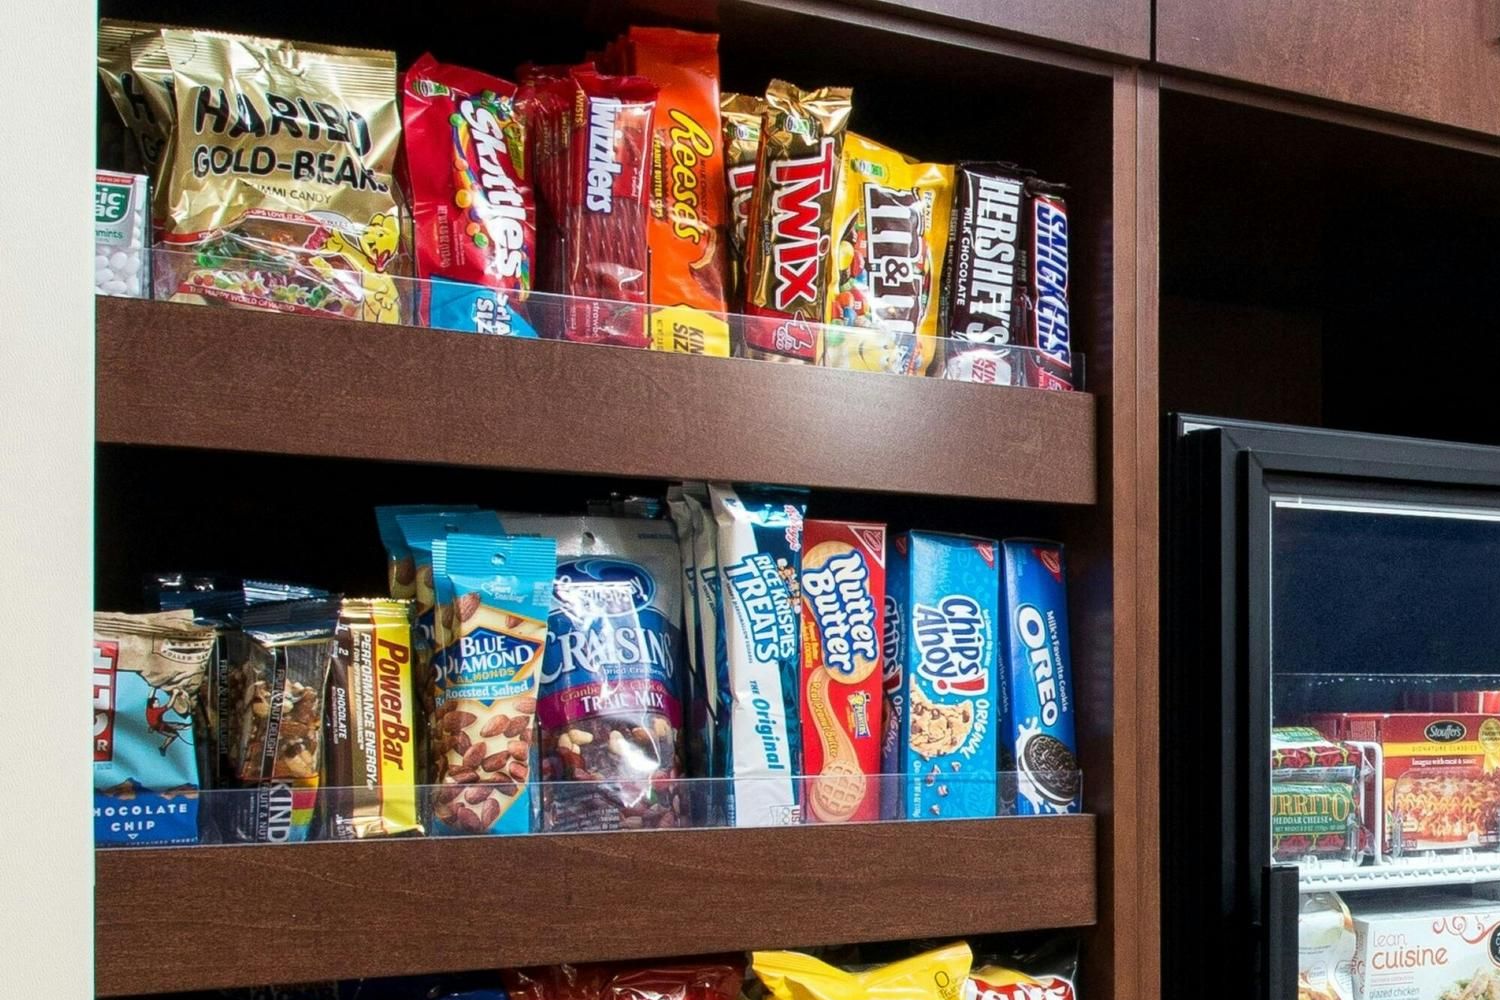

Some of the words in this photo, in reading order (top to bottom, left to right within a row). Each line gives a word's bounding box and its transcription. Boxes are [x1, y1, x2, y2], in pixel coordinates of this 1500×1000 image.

[461, 100, 526, 278] Skittles
[669, 109, 714, 245] Reese's
[290, 189, 332, 204] CANDY
[962, 207, 973, 236] MILK
[957, 238, 971, 306] CHOCOLATE
[967, 177, 1024, 345] HERSHEY'S
[1036, 203, 1071, 367] SNICKERS
[475, 297, 494, 334] SIZ
[674, 322, 689, 353] SIZ
[689, 327, 704, 354] KIN
[971, 356, 984, 383] SIZ
[981, 357, 998, 384] KIN
[724, 559, 778, 663] TREATS
[755, 555, 783, 588] RICE
[770, 589, 797, 658] KRISPIES
[803, 568, 853, 673] Butter
[828, 552, 878, 662] Nutter
[943, 598, 982, 676] Chips
[1046, 609, 1060, 639] Milk's
[446, 644, 535, 678] DIAMOND
[460, 633, 506, 658] BLUE
[540, 626, 674, 684] CRAISINS
[1052, 641, 1065, 680] Favorite
[274, 668, 285, 691] FRUIT
[361, 633, 376, 728] PERFORMANCE
[456, 667, 516, 685] ALMONDS
[1017, 604, 1059, 727] OREO
[446, 684, 490, 701] Roasted
[491, 680, 528, 697] Salted
[635, 691, 664, 709] MIX
[748, 680, 758, 694] THE
[810, 680, 823, 701] Real
[1057, 681, 1069, 712] Cookie
[270, 702, 282, 720] NUT
[336, 688, 347, 739] CHOCOLATE
[377, 638, 411, 771] PowerBar
[811, 703, 830, 729] Peanut
[265, 722, 278, 757] DELIGHT
[751, 698, 785, 769] Original
[960, 698, 991, 760] ORIGINAL
[1429, 724, 1462, 739] Stouffer's
[364, 729, 377, 781] ENERGY
[94, 803, 188, 817] HOCOLATE
[267, 779, 293, 843] KIND
[1271, 793, 1350, 821] URRITO
[1272, 816, 1303, 825] HEDDAR
[111, 820, 155, 832] CHIP
[259, 821, 268, 841] NUT
[1373, 931, 1408, 949] lean
[1371, 945, 1449, 970] cuisine
[1394, 986, 1420, 999] chicken
